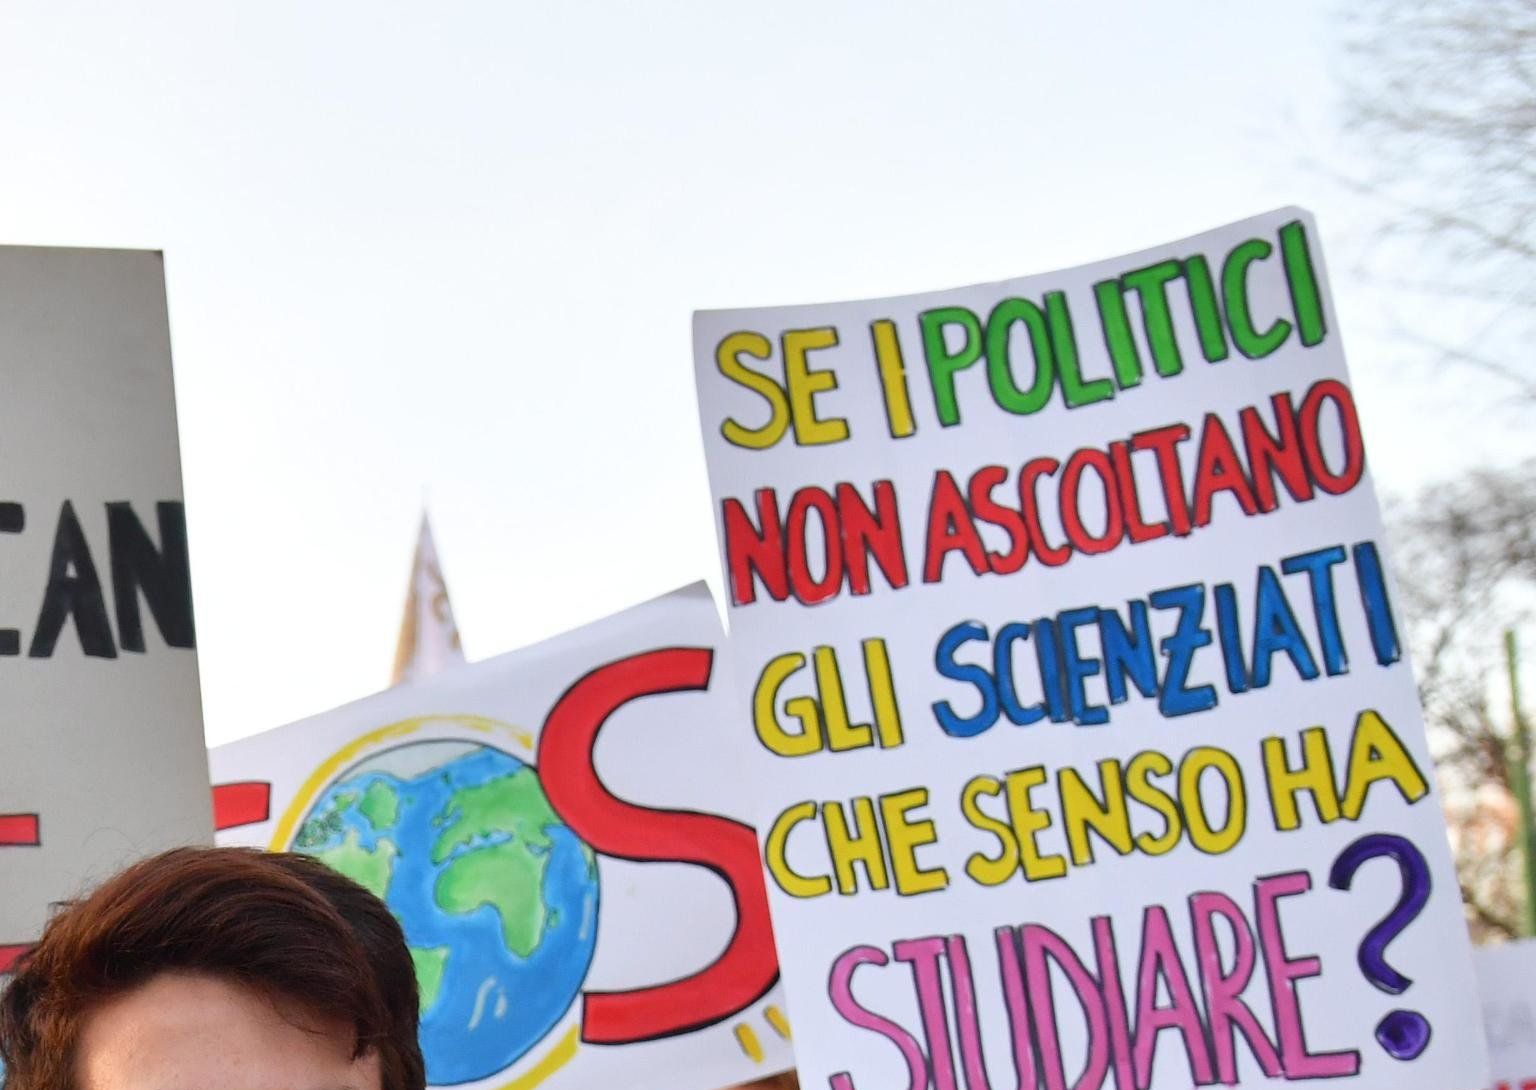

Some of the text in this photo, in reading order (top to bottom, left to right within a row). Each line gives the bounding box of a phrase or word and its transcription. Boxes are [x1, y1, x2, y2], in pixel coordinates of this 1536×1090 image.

[715, 219, 1327, 449] SE I POLITICI
[721, 378, 1365, 607] NON ASCOLTANO
[752, 541, 1402, 758] GLI SCIENZIATI
[765, 708, 1430, 899] CHE SENSO HA
